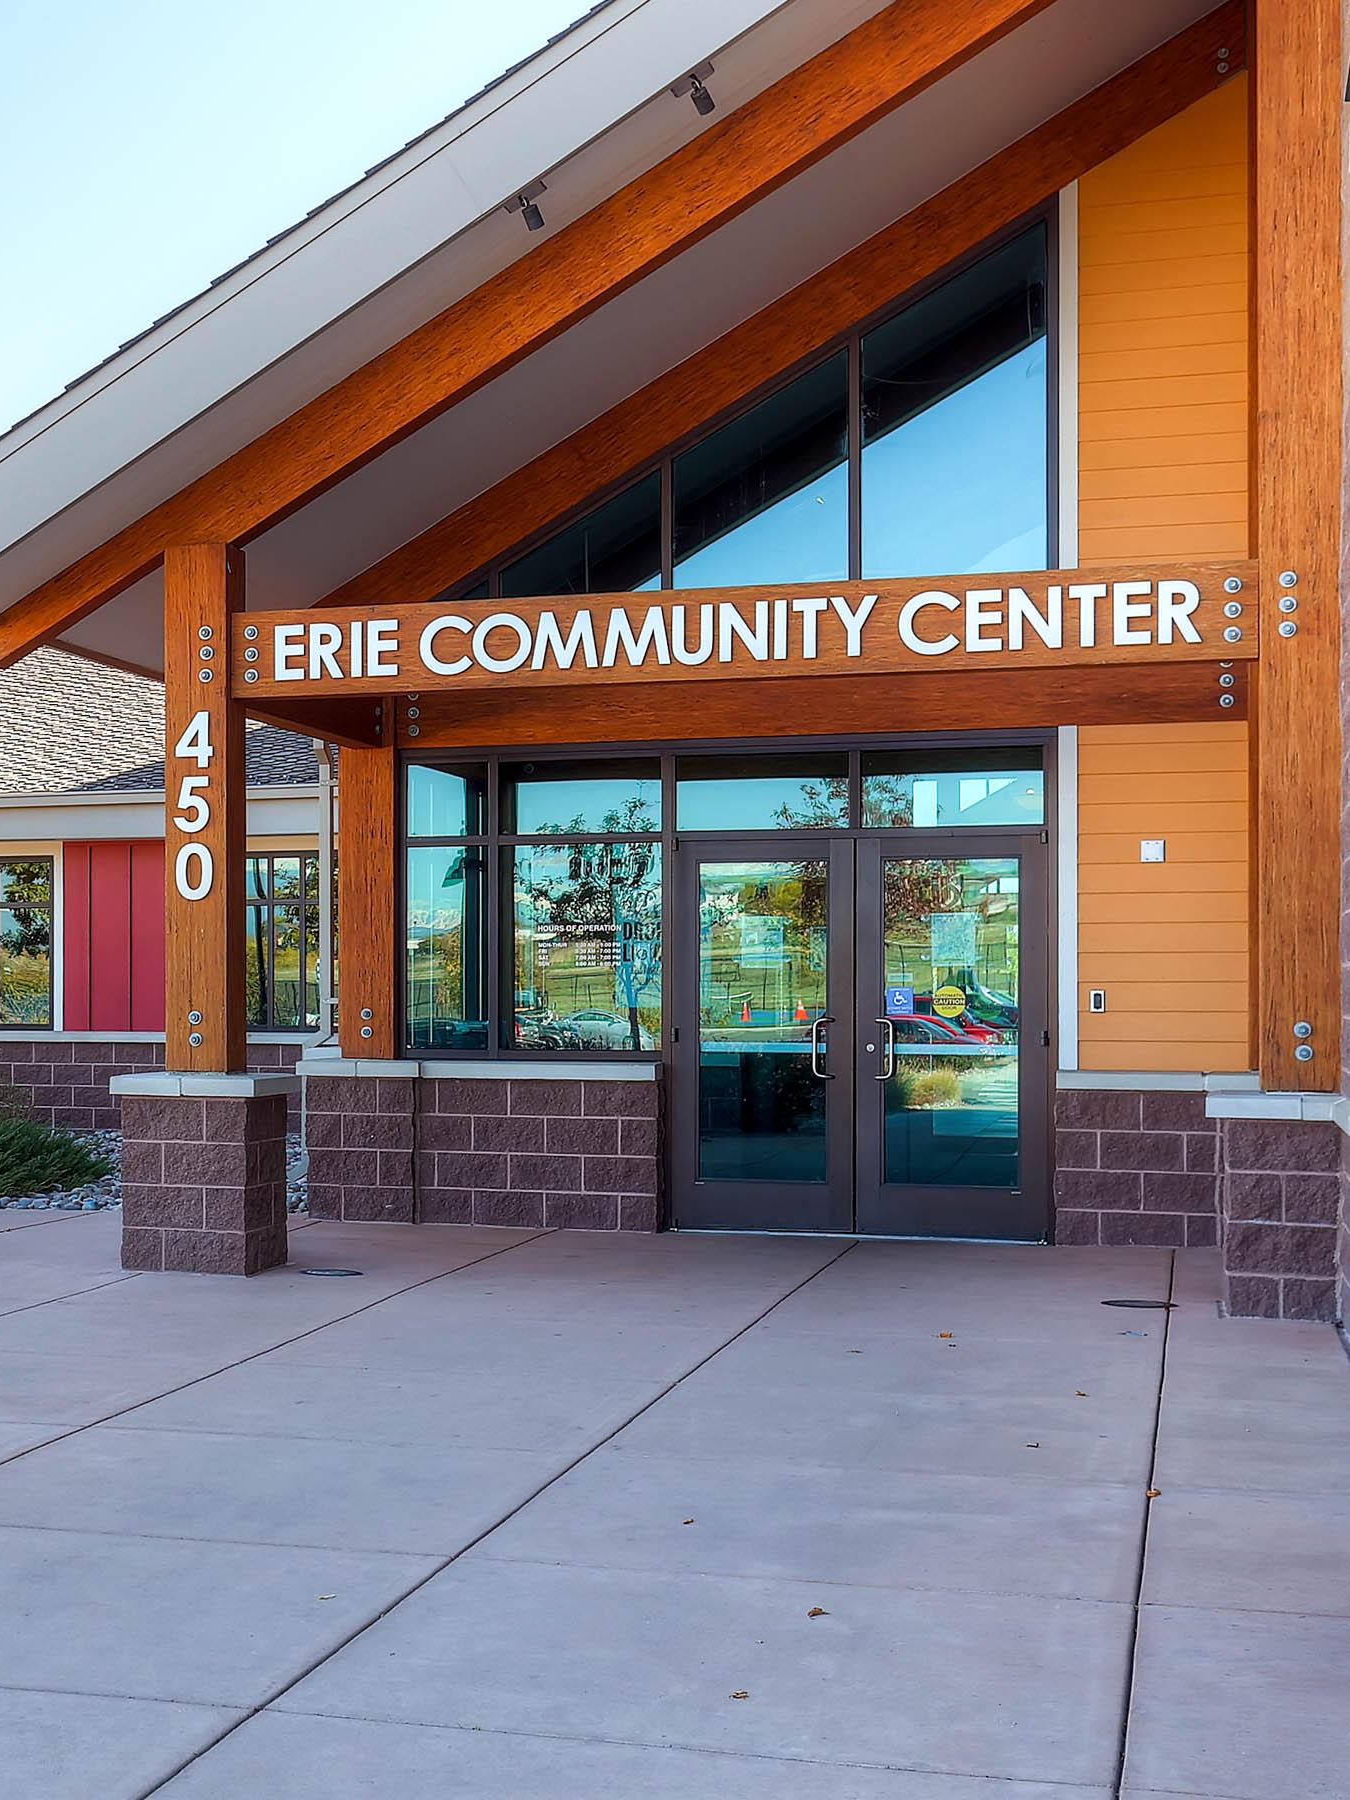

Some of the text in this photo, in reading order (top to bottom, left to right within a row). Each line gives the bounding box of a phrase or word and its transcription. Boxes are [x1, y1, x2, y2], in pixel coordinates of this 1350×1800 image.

[273, 579, 1204, 682] ERIE COMMUNITY CENTER
[172, 710, 214, 902] 450
[537, 924, 622, 932] HOURS OF OPERATION
